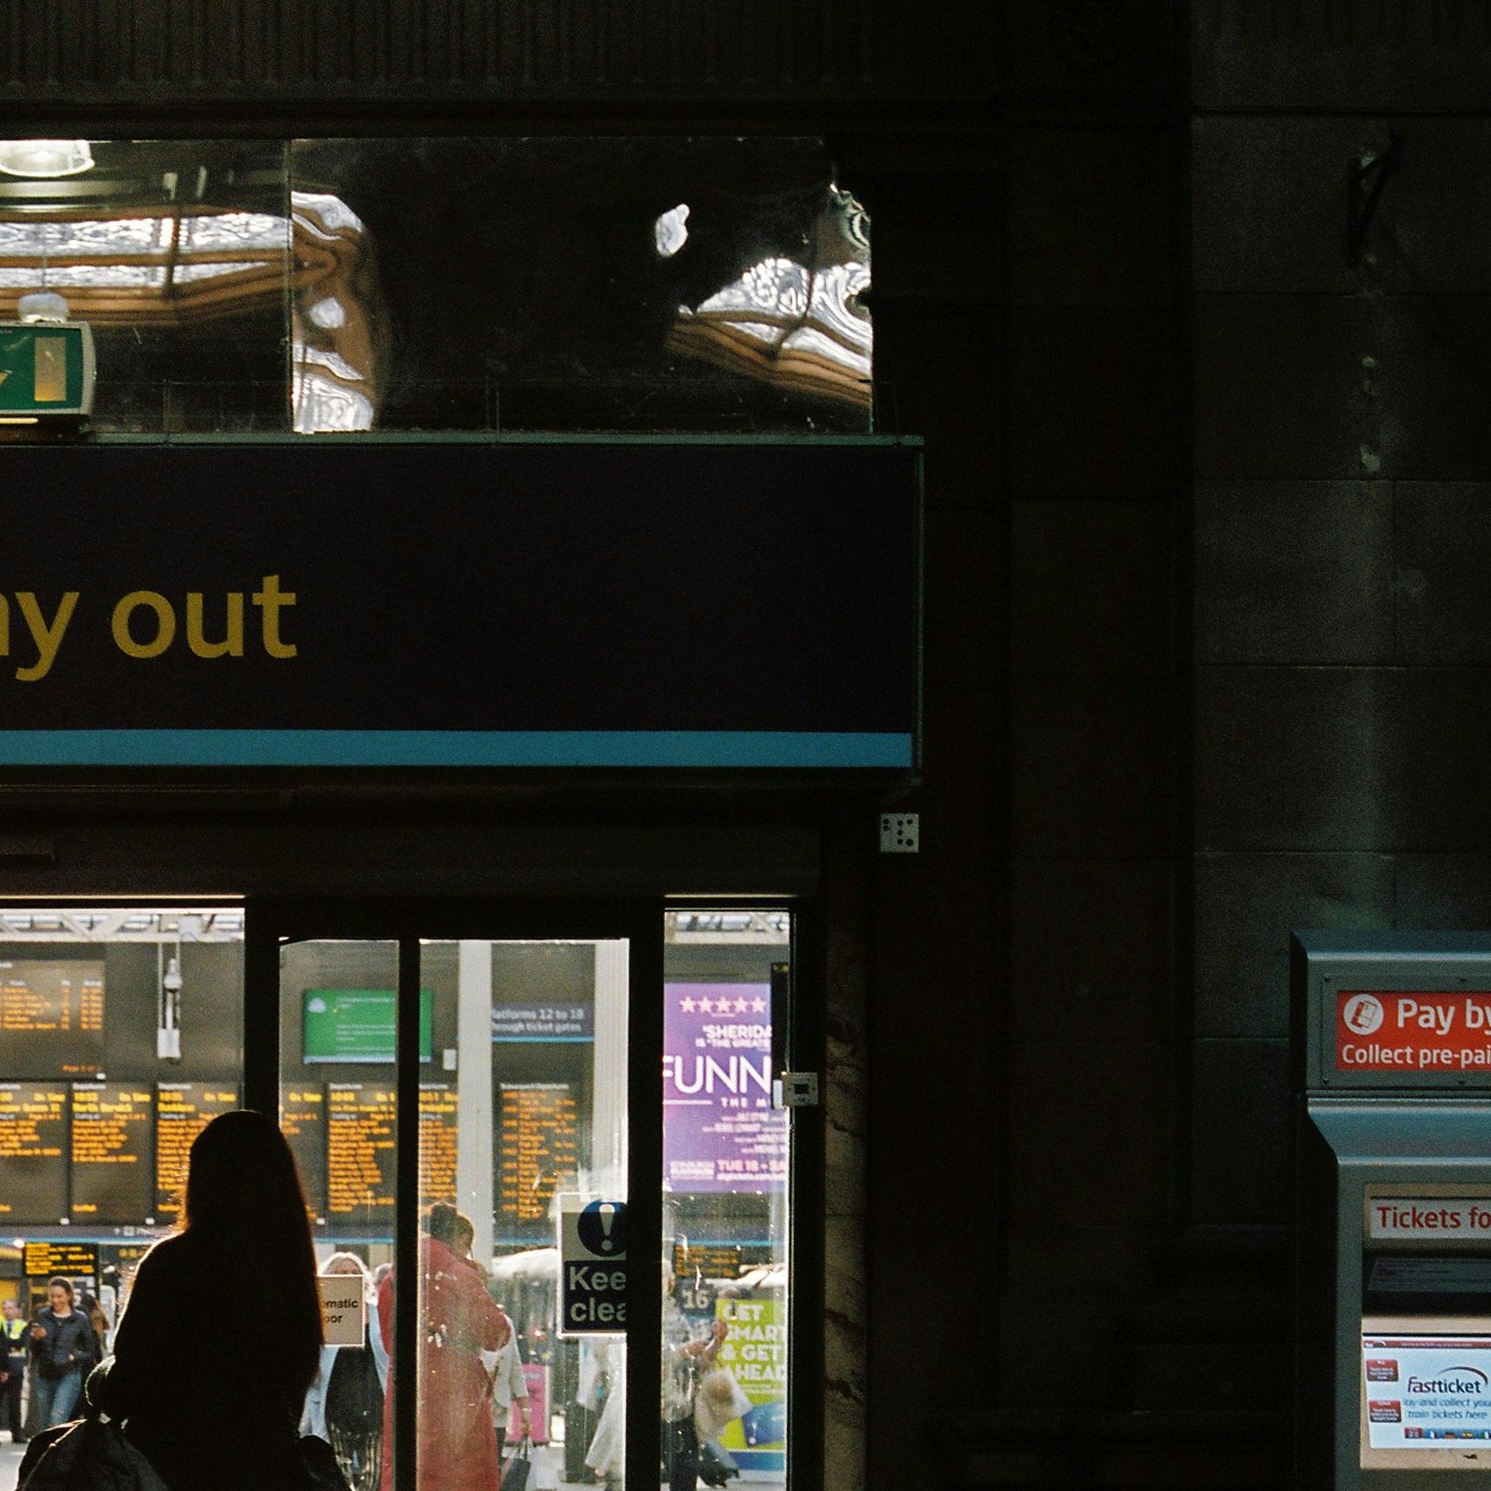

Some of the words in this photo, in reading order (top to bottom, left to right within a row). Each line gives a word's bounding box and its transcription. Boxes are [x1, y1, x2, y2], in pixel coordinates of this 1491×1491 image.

[111, 575, 298, 659] out
[555, 1009, 568, 1020] to
[1397, 998, 1456, 1036] Pay
[1342, 1044, 1413, 1064] Collect
[1377, 1206, 1461, 1229] Tickets
[570, 1266, 627, 1290] Kee
[741, 1344, 782, 1361] GET
[1407, 1376, 1482, 1393] fastticket
[1419, 1398, 1437, 1407] and
[1439, 1398, 1470, 1407] collect
[1432, 1410, 1463, 1420] tickets
[1465, 1410, 1487, 1419] here
